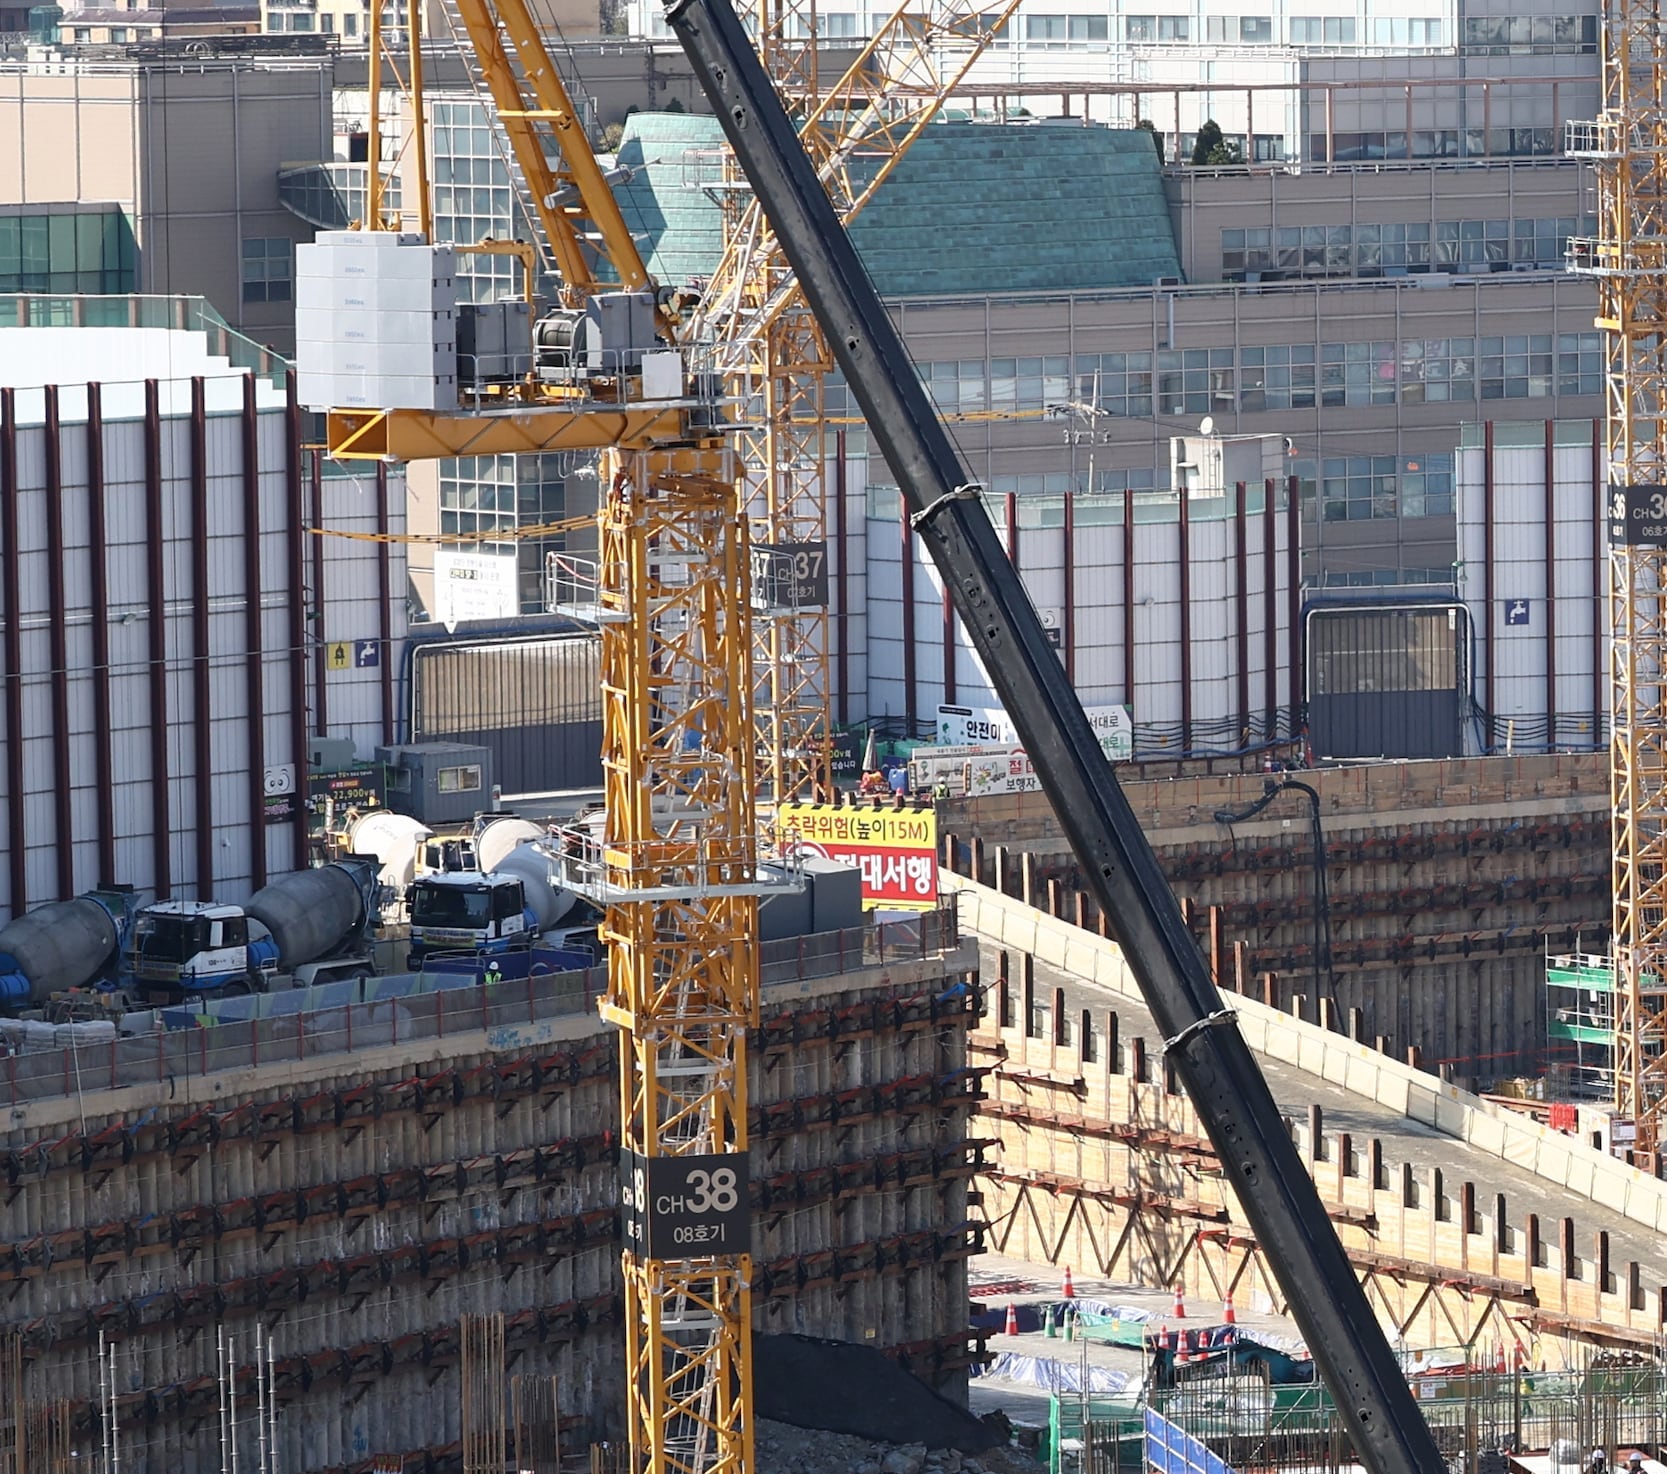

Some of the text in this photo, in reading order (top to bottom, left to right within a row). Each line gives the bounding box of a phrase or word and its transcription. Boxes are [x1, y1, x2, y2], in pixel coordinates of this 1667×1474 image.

[1006, 777, 1036, 791] 보행자
[656, 1167, 738, 1215] CH38
[673, 1222, 725, 1244] 08호기
